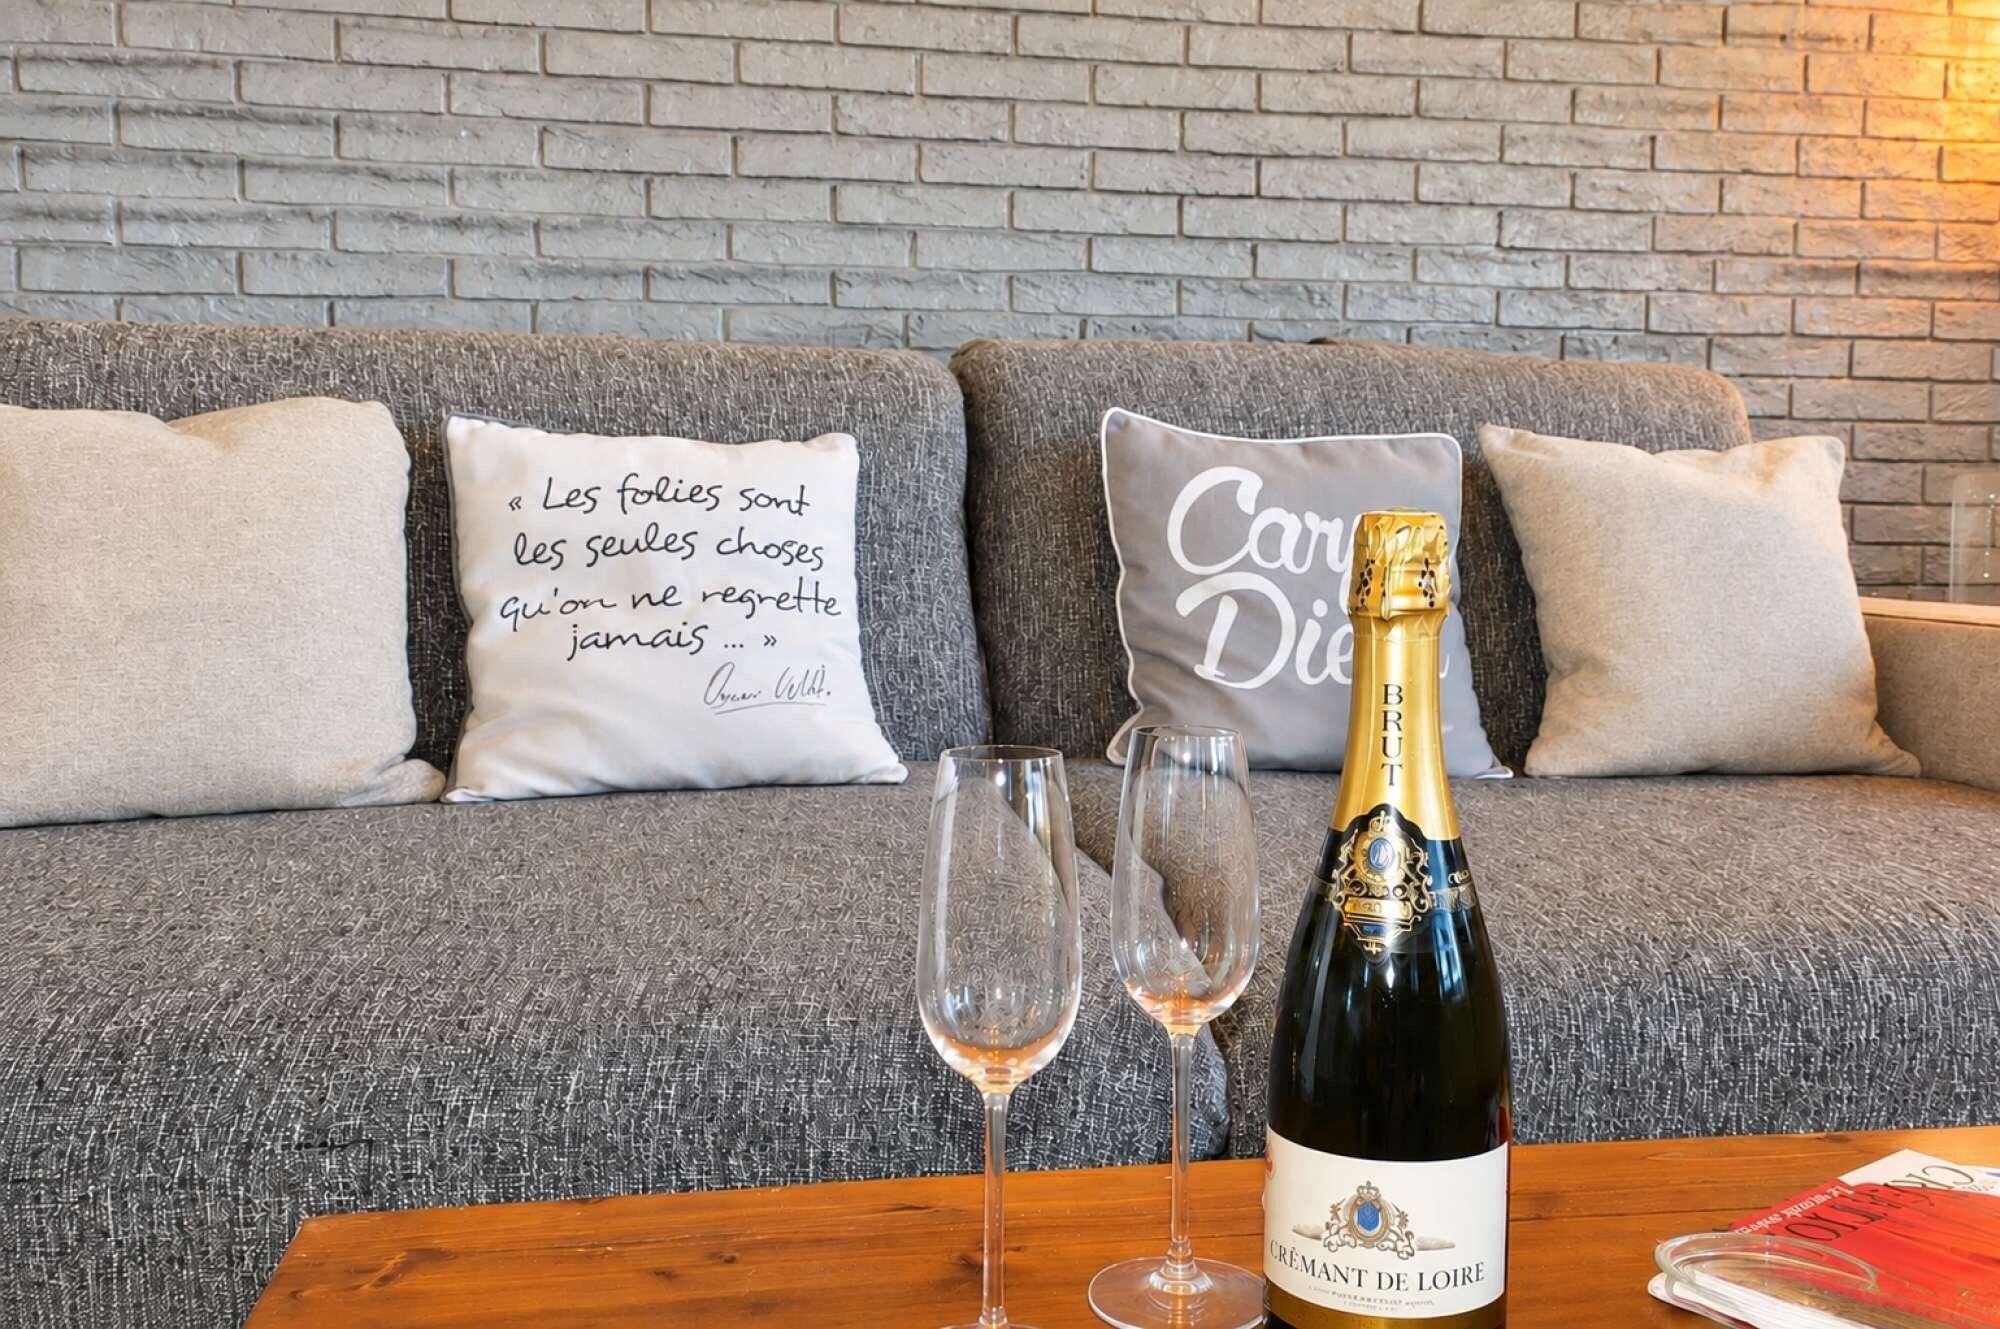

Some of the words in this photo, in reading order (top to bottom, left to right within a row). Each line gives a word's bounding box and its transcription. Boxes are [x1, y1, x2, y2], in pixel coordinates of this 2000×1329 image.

[542, 477, 602, 514] Les
[616, 473, 723, 514] folies
[738, 484, 811, 516] sont
[514, 532, 566, 570] les
[585, 522, 699, 568] seules
[716, 526, 825, 571] choses
[499, 588, 616, 632] qu'on
[631, 584, 682, 608] ne
[701, 576, 842, 619] regrette
[566, 621, 709, 661] jamais
[1175, 571, 1450, 690] Die
[1381, 683, 1404, 787] BRUT
[1376, 1271, 1409, 1292] DE
[1418, 1261, 1485, 1292] LOIRE
